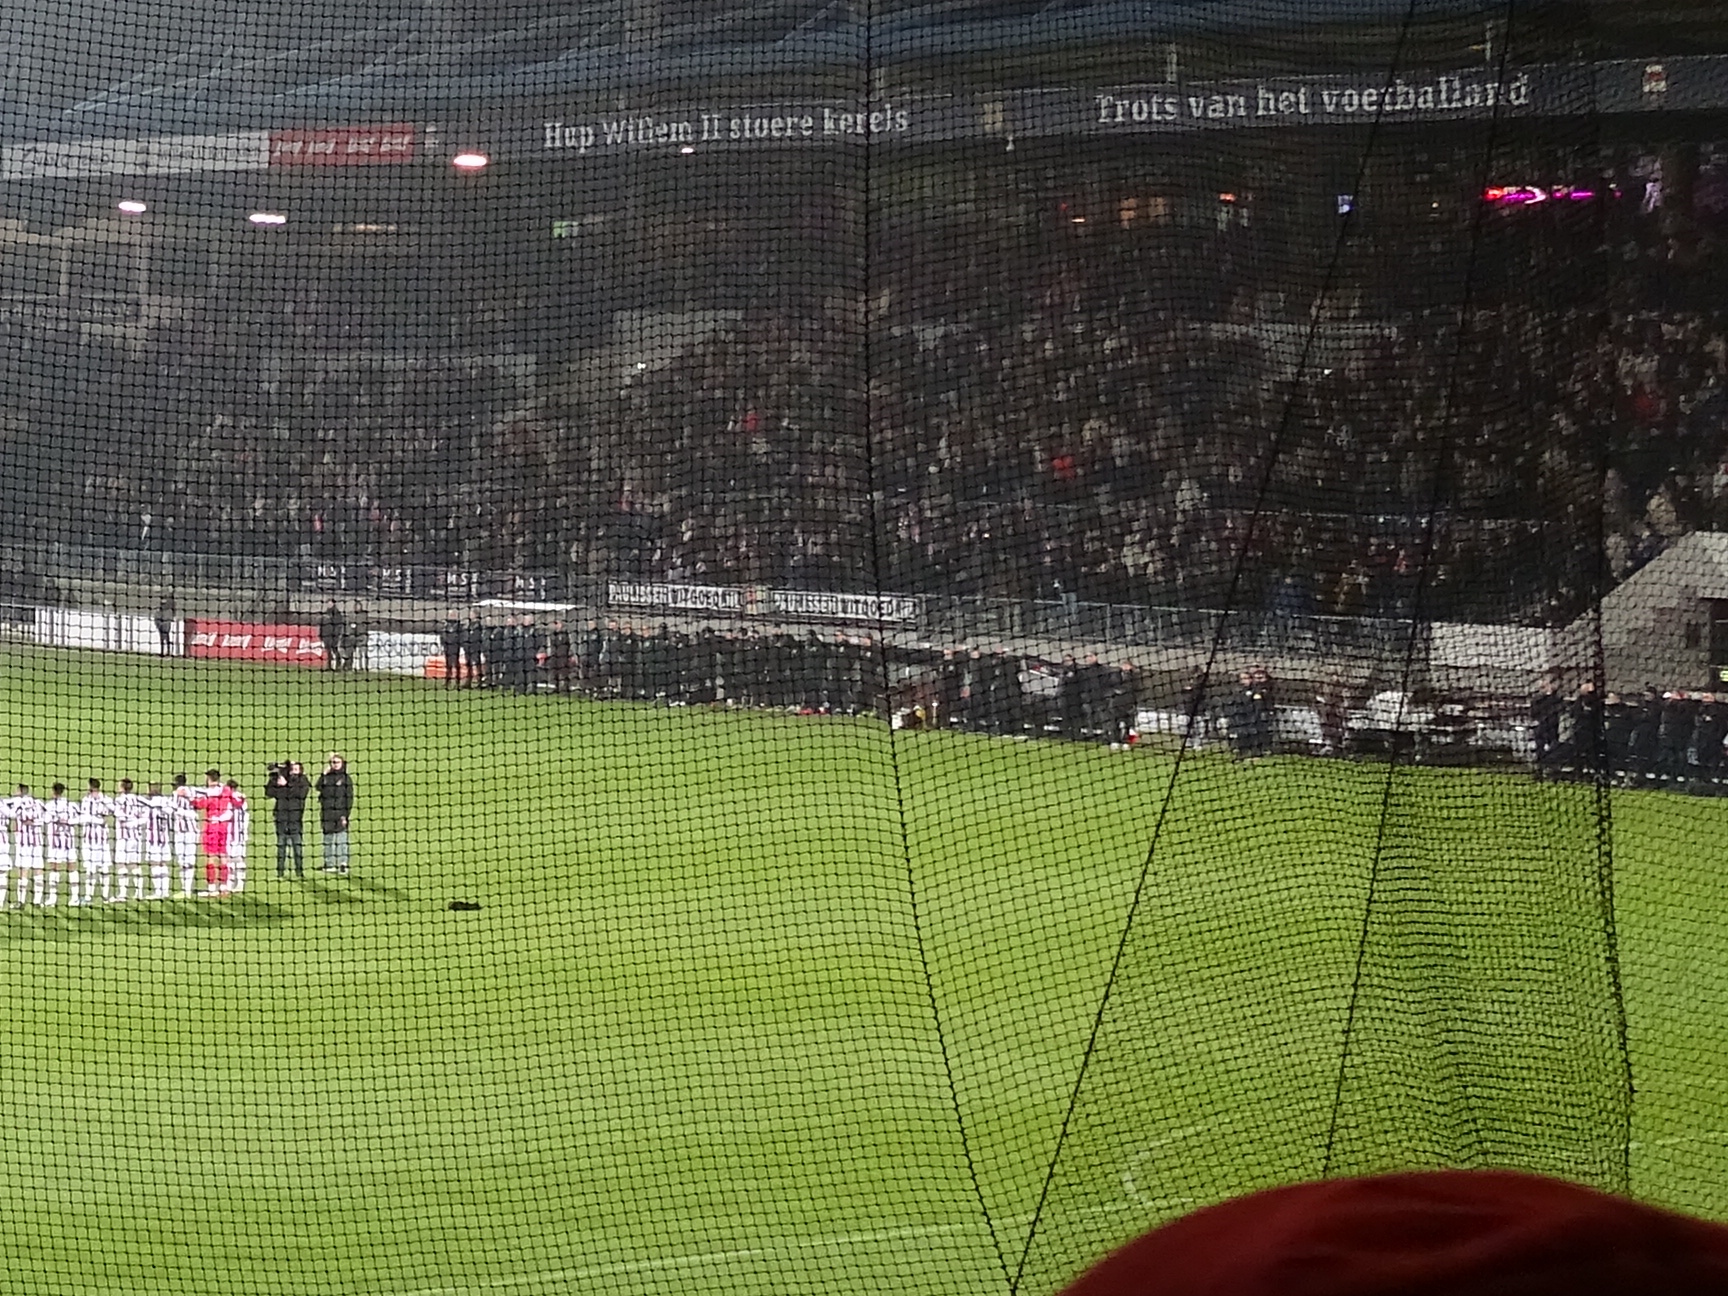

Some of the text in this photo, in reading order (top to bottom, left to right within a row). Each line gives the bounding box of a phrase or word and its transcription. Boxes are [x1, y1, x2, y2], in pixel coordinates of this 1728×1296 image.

[1096, 72, 1531, 123] Trots van het voetballand
[543, 103, 909, 153] Hup Willem II stoere kerels
